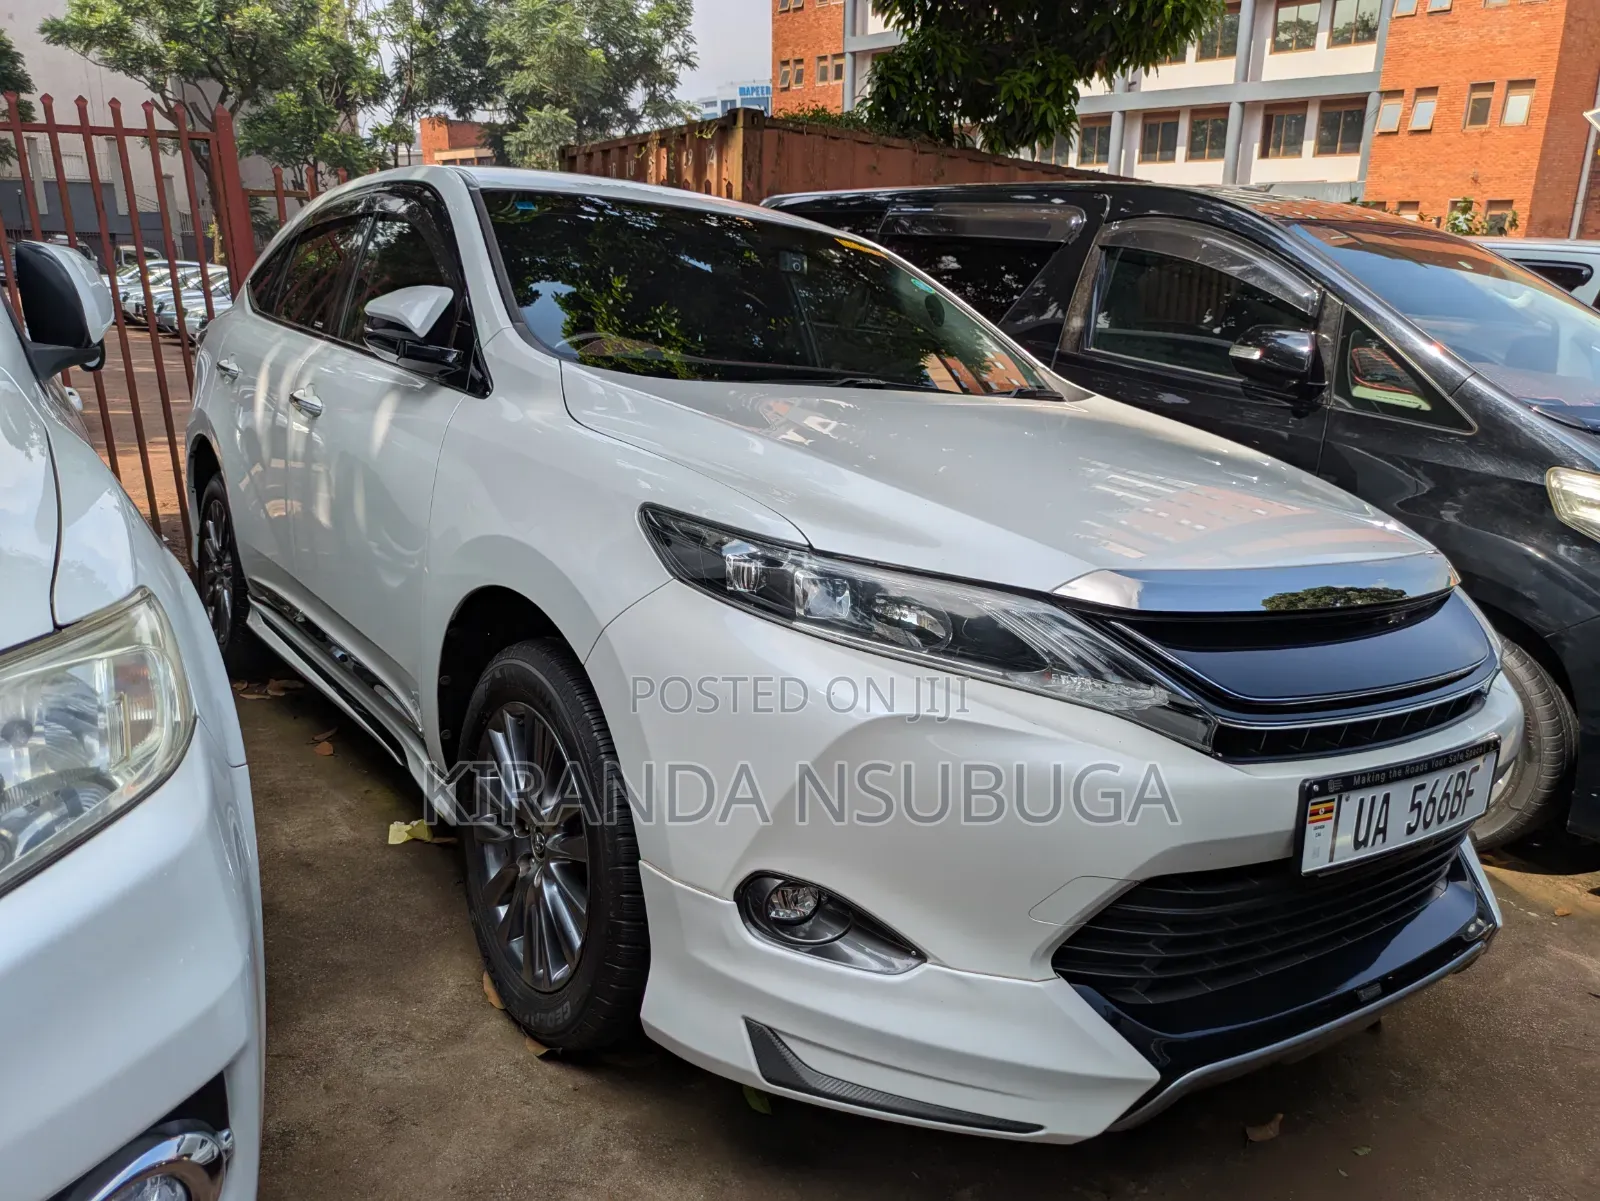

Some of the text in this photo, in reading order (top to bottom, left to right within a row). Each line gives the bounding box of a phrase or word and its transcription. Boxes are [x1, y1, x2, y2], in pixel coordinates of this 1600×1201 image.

[1352, 771, 1386, 787] Making
[1389, 767, 1402, 779] the
[1404, 762, 1429, 776] Roads
[1431, 757, 1447, 769] Your
[1448, 752, 1464, 765] Safe
[1352, 764, 1480, 851] UA 566BF
